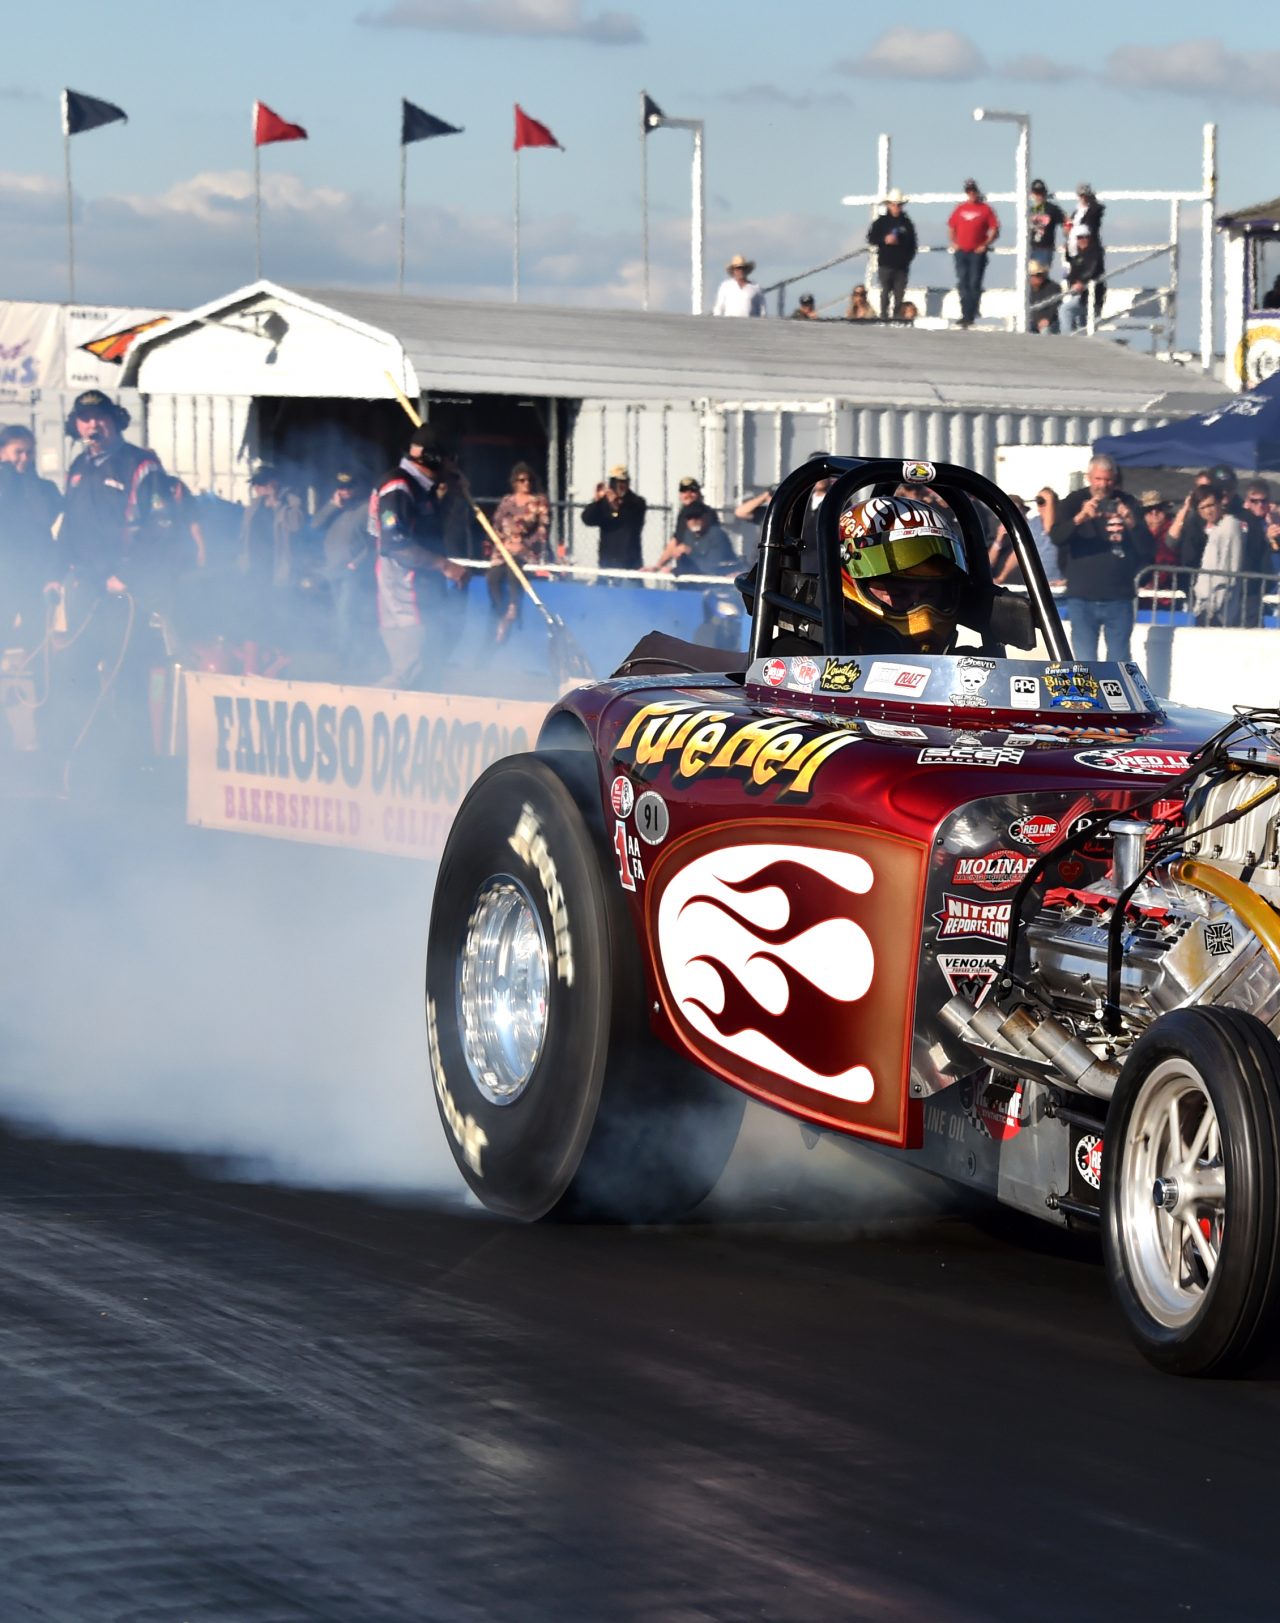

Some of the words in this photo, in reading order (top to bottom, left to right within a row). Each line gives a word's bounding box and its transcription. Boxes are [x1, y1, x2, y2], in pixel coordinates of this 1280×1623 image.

[1015, 679, 1035, 693] PPG
[1104, 682, 1123, 697] PPG
[213, 695, 365, 789] FAMOSO
[224, 784, 362, 837] BAKERSFIELD
[644, 803, 659, 832] 91
[1023, 824, 1039, 834] RED
[1040, 823, 1057, 834] LINE
[628, 835, 642, 859] AA
[948, 899, 1012, 921] NITRO
[943, 917, 1009, 940] REPORTS.COM
[948, 1116, 966, 1143] OIL
